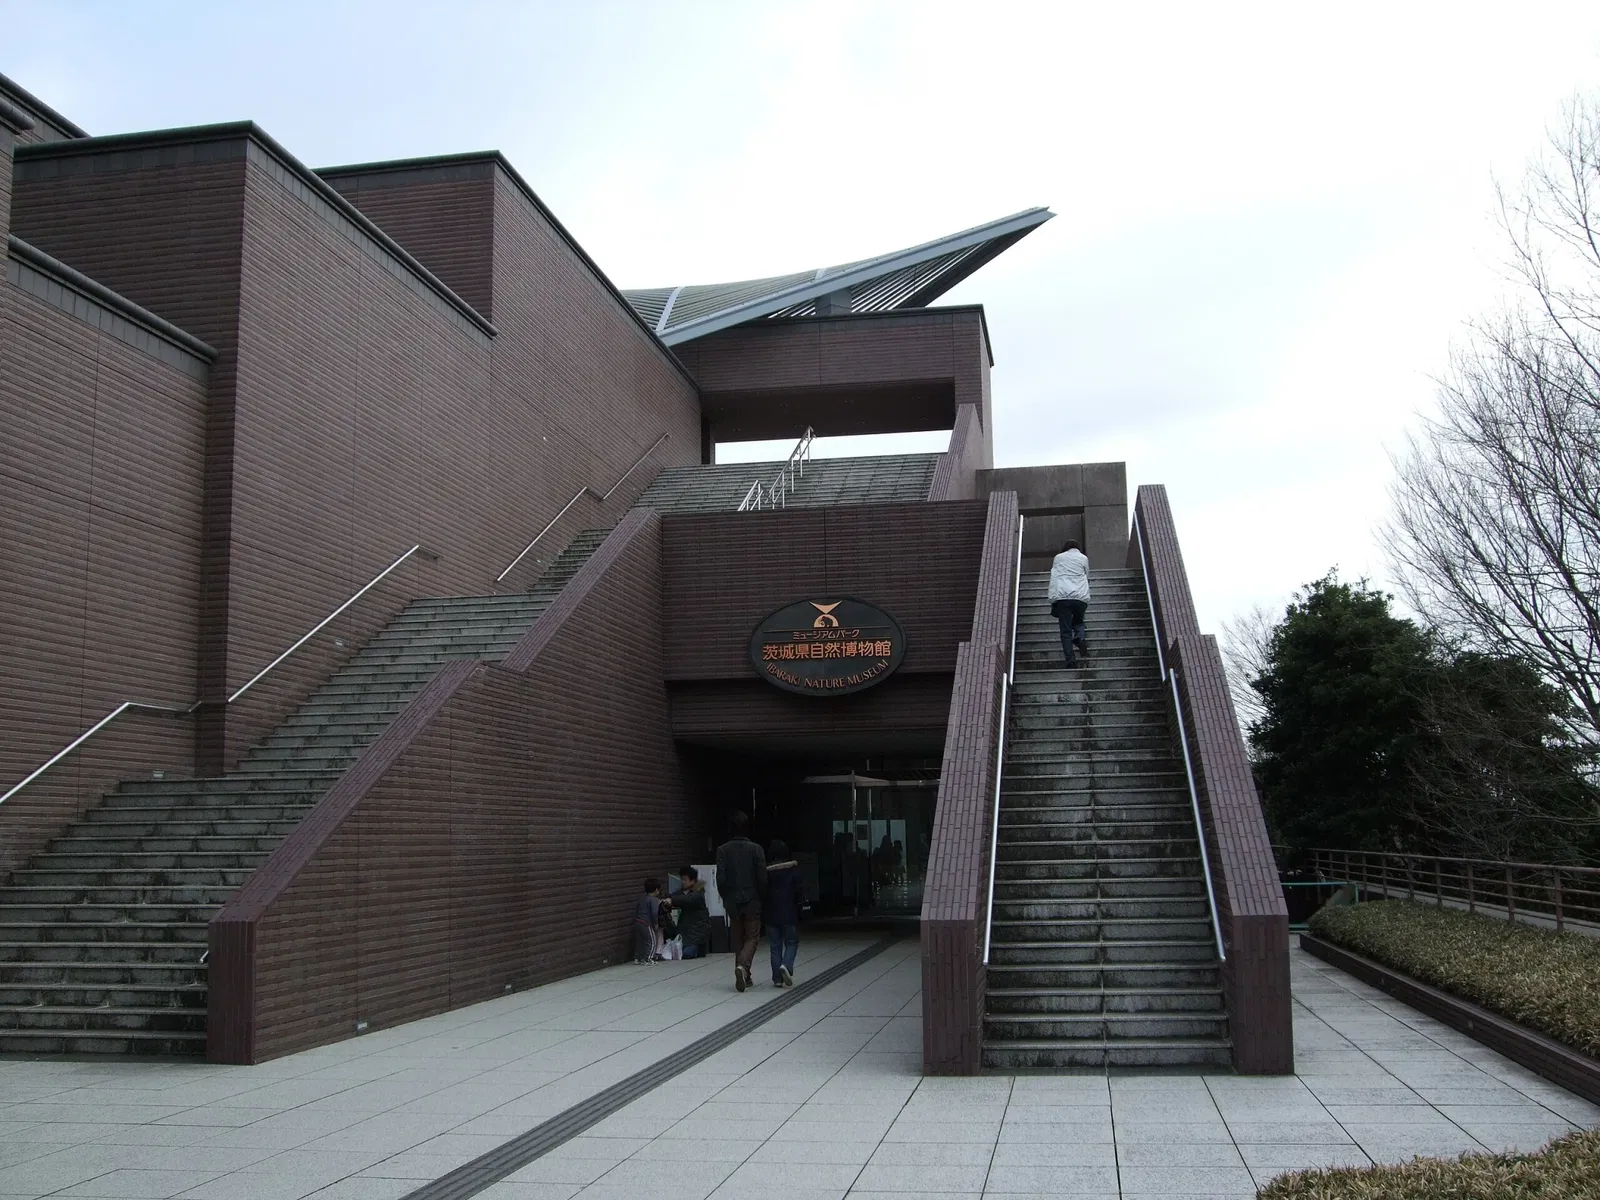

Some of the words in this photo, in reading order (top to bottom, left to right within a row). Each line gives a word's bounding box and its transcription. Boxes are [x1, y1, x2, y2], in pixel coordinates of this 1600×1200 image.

[793, 629, 860, 640] ミュージアムパーク
[762, 640, 892, 661] 茨城県自然博物館
[766, 662, 800, 686] IBARAKI
[803, 677, 845, 689] NATURE
[847, 659, 889, 686] MUSEUM
